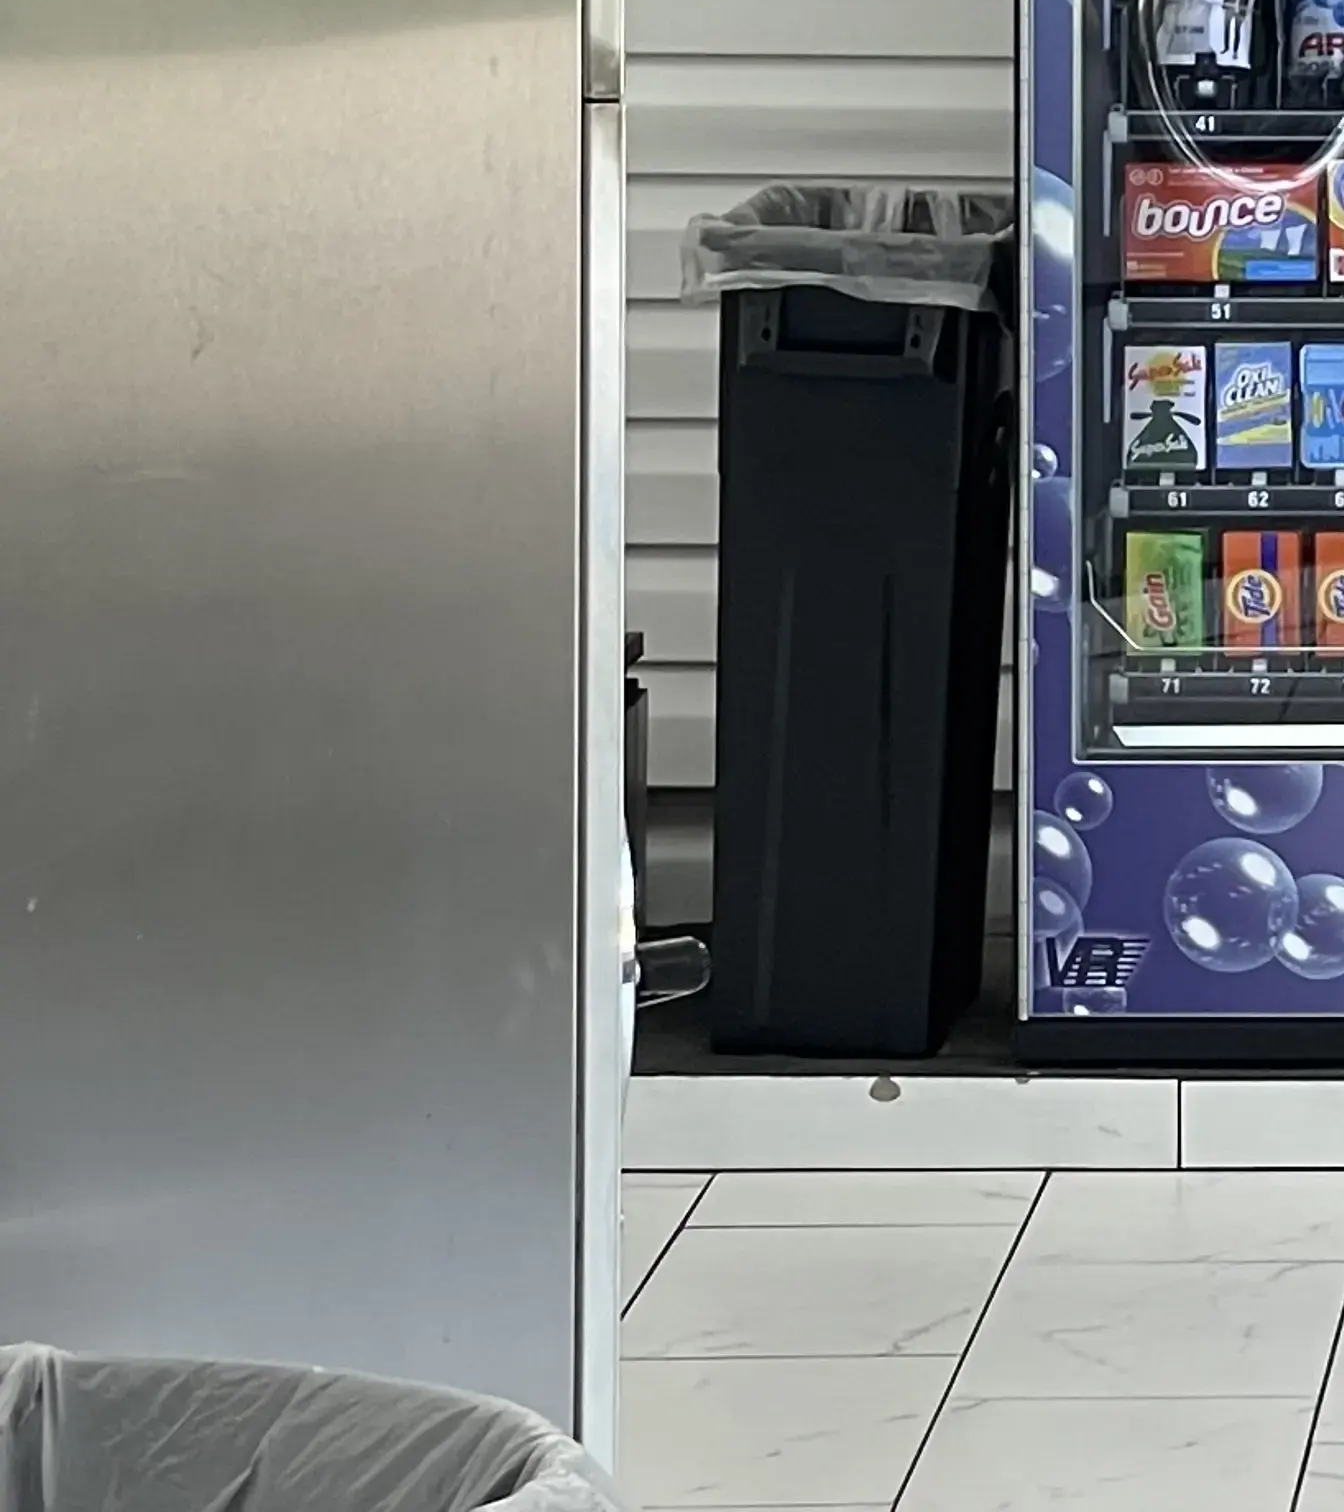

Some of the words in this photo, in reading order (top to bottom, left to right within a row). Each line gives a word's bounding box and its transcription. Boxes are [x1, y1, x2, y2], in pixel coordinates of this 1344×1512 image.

[1195, 115, 1215, 132] 41
[1137, 193, 1283, 237] bounce
[1211, 303, 1231, 320] 51
[1237, 367, 1269, 387] OXI
[1225, 378, 1279, 404] CLEAN
[1167, 491, 1187, 508] 61
[1247, 491, 1269, 508] 62
[1241, 574, 1271, 617] Tide
[1161, 678, 1181, 694] 71
[1250, 678, 1271, 694] 72
